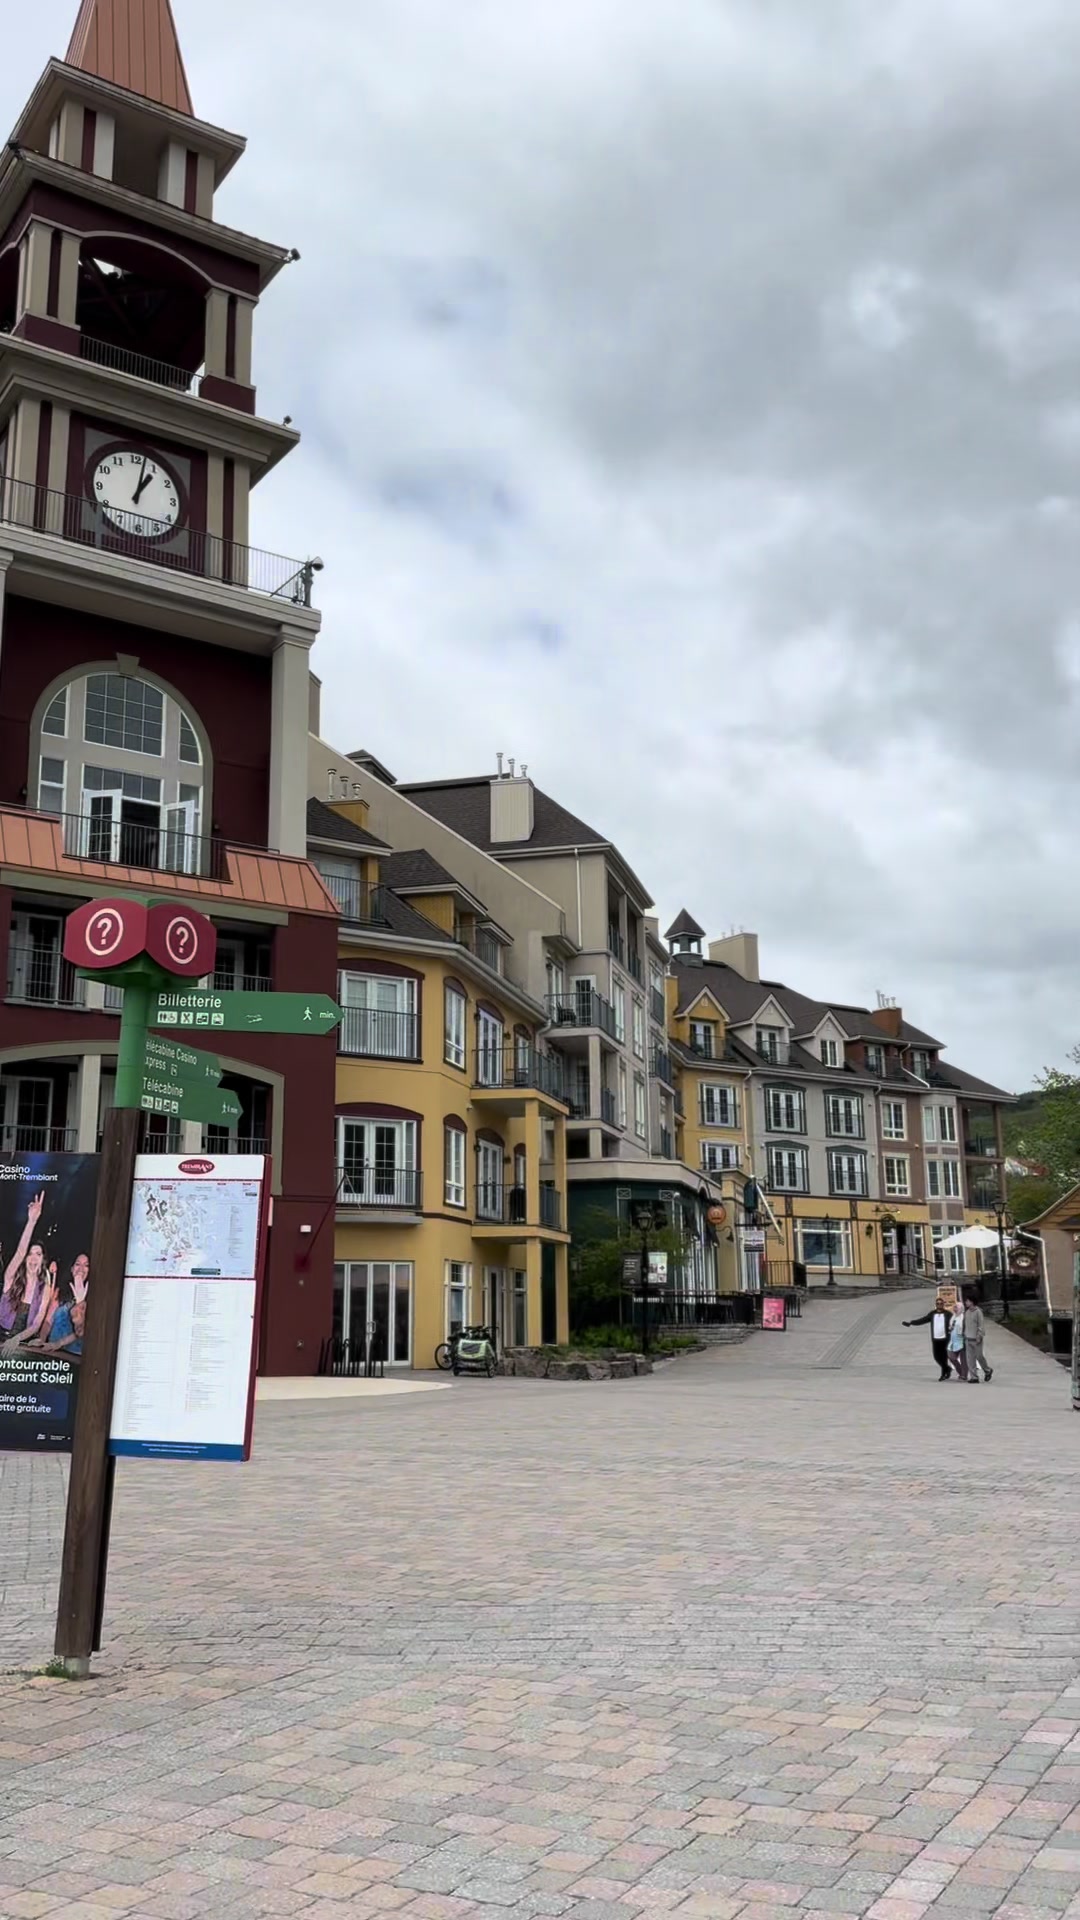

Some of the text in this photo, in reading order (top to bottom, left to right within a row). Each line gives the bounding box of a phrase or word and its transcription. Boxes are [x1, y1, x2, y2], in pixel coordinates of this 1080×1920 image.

[112, 456, 124, 466] 11
[130, 454, 142, 465] 12
[99, 465, 110, 475] 10
[151, 464, 157, 473] 1
[96, 481, 103, 490] 9
[164, 479, 171, 489] 2
[103, 499, 110, 508] 8
[170, 497, 177, 507] 3
[117, 515, 124, 524] 7
[165, 514, 172, 522] 4
[135, 524, 142, 533] 6
[153, 523, 160, 532] 5
[97, 917, 113, 945] ?
[176, 926, 190, 953] ?
[157, 993, 222, 1008] Billetterie
[319, 1010, 337, 1019] min.
[176, 1048, 198, 1065] Casino
[143, 1076, 184, 1098] Télécabine
[0, 1164, 30, 1173] Casino
[0, 1372, 73, 1384] ersant Soleil
[16, 1394, 27, 1403] de
[28, 1395, 37, 1403] la
[17, 1404, 52, 1414] gratuite
